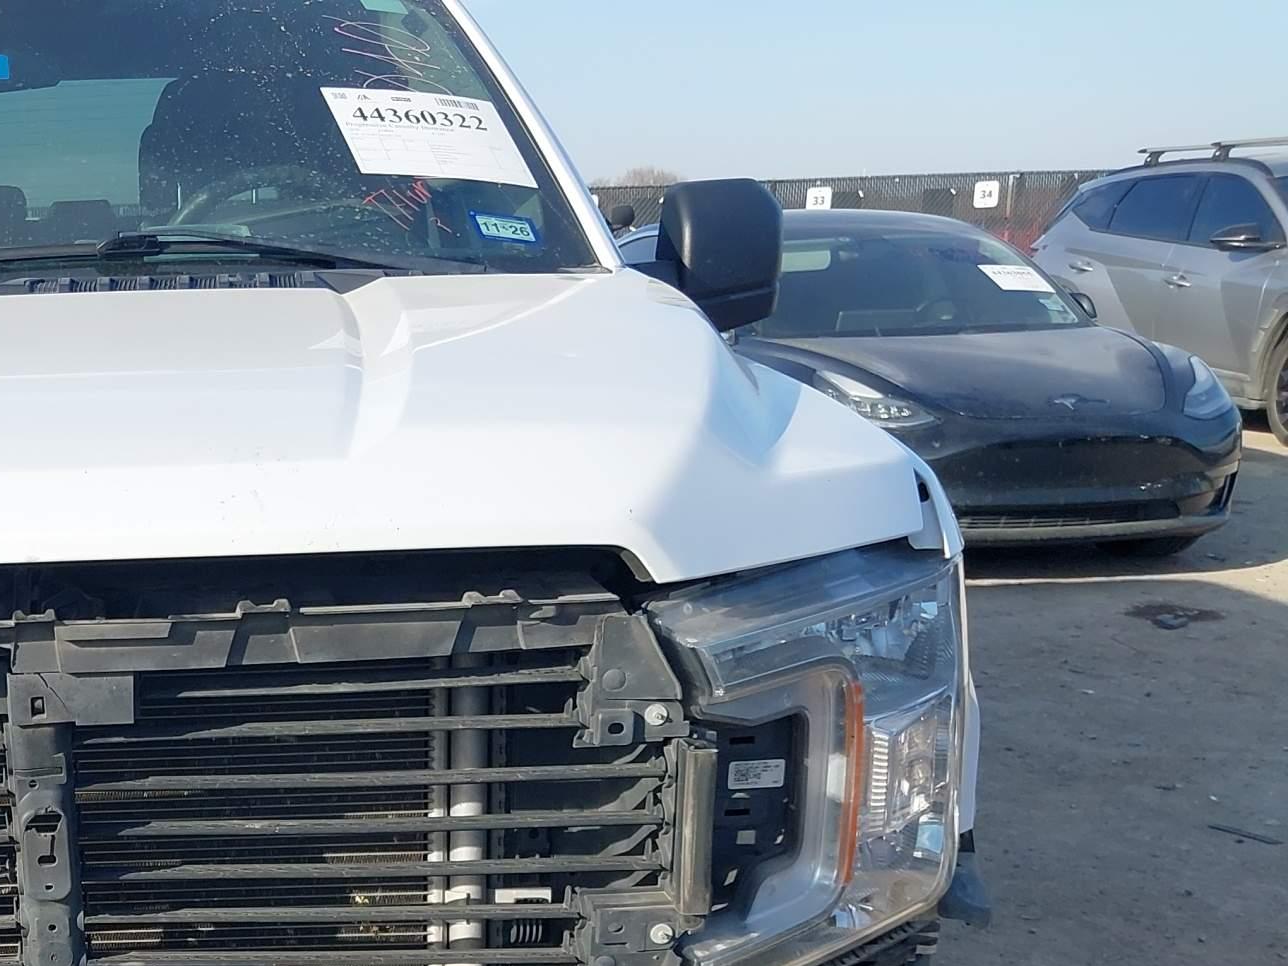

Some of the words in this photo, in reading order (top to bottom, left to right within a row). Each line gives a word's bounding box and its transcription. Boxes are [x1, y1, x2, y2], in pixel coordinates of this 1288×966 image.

[352, 106, 488, 132] 44360322
[979, 190, 993, 199] 34
[812, 195, 825, 206] 33
